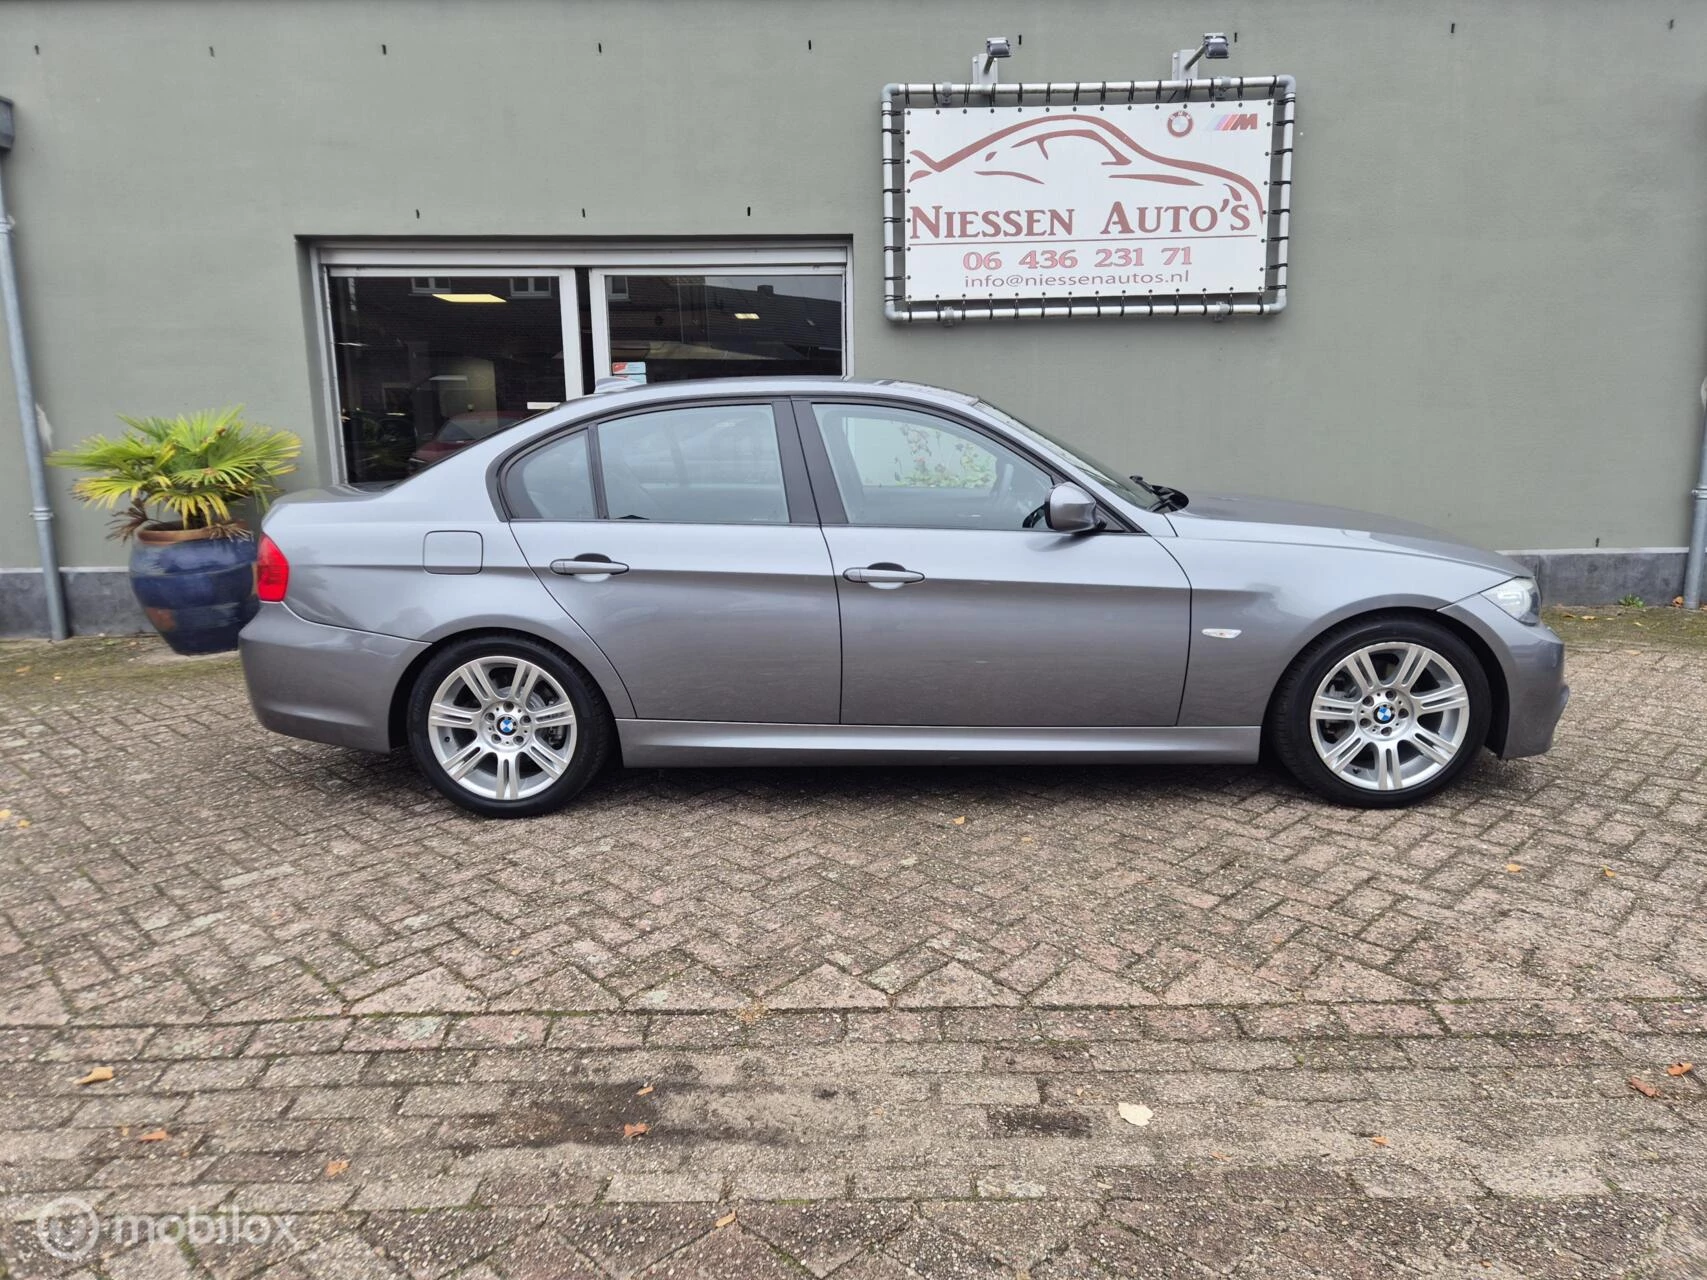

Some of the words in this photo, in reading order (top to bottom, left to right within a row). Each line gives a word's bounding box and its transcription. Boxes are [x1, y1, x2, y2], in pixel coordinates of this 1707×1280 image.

[962, 251, 1003, 271] 06
[1018, 249, 1079, 270] 436
[1094, 247, 1145, 268] 231
[1161, 246, 1193, 266] 71
[964, 270, 1190, 288] info@niessenautos.nl
